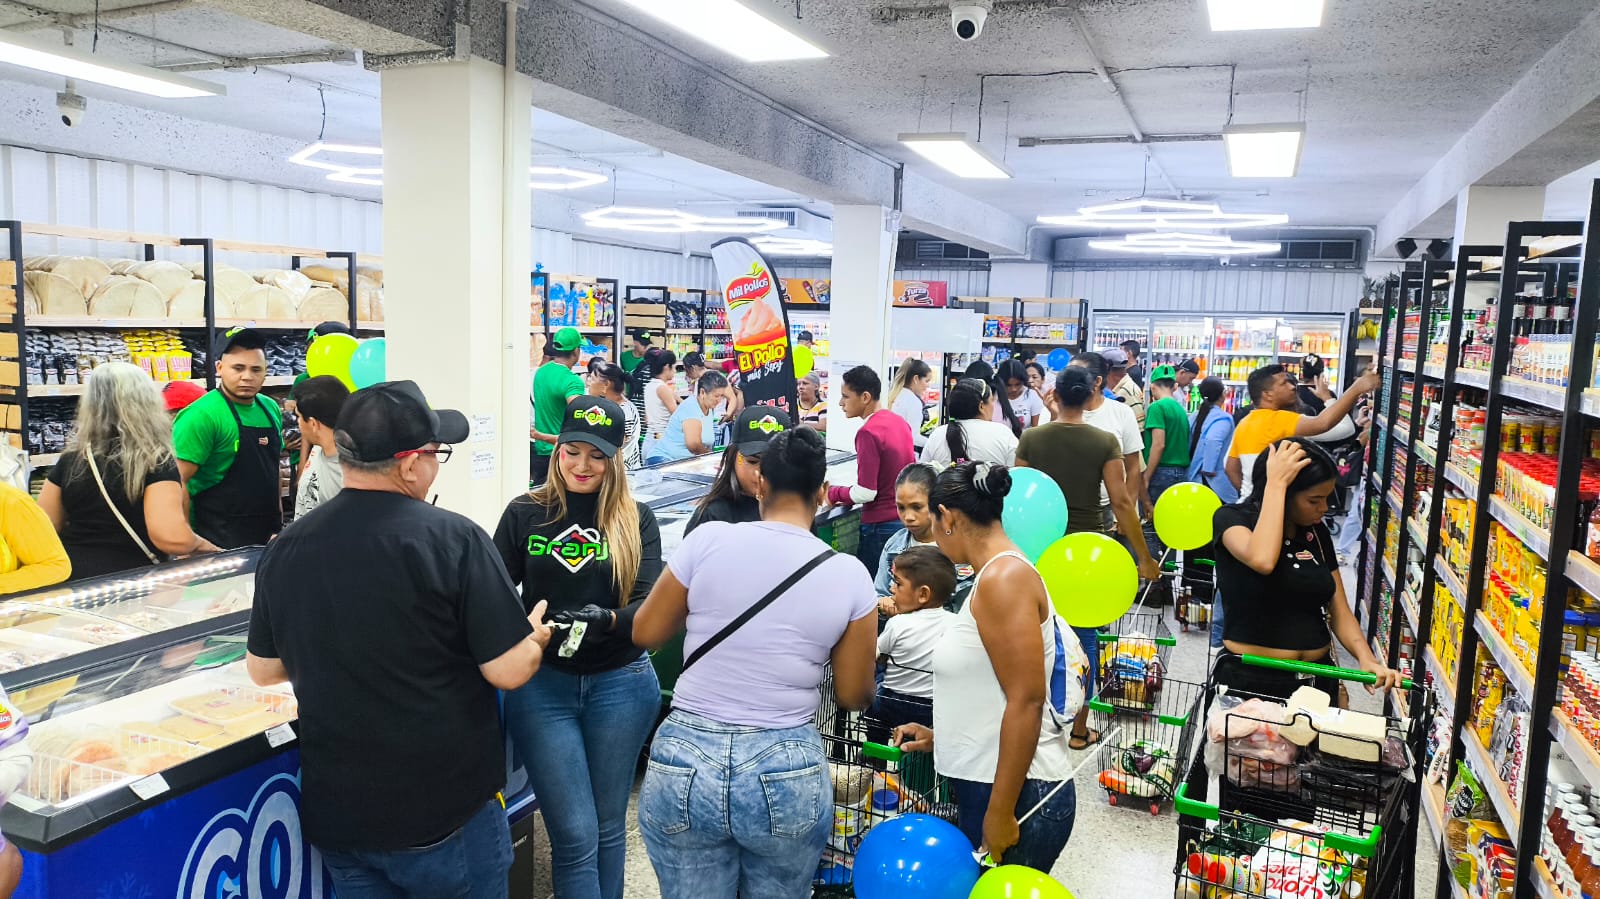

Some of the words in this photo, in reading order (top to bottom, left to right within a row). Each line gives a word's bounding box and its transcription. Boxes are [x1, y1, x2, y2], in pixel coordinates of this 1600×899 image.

[728, 285, 744, 300] Mil
[743, 277, 769, 295] Pollos
[753, 344, 786, 367] Pollo
[573, 409, 613, 426] Granja
[527, 534, 609, 562] Granj
